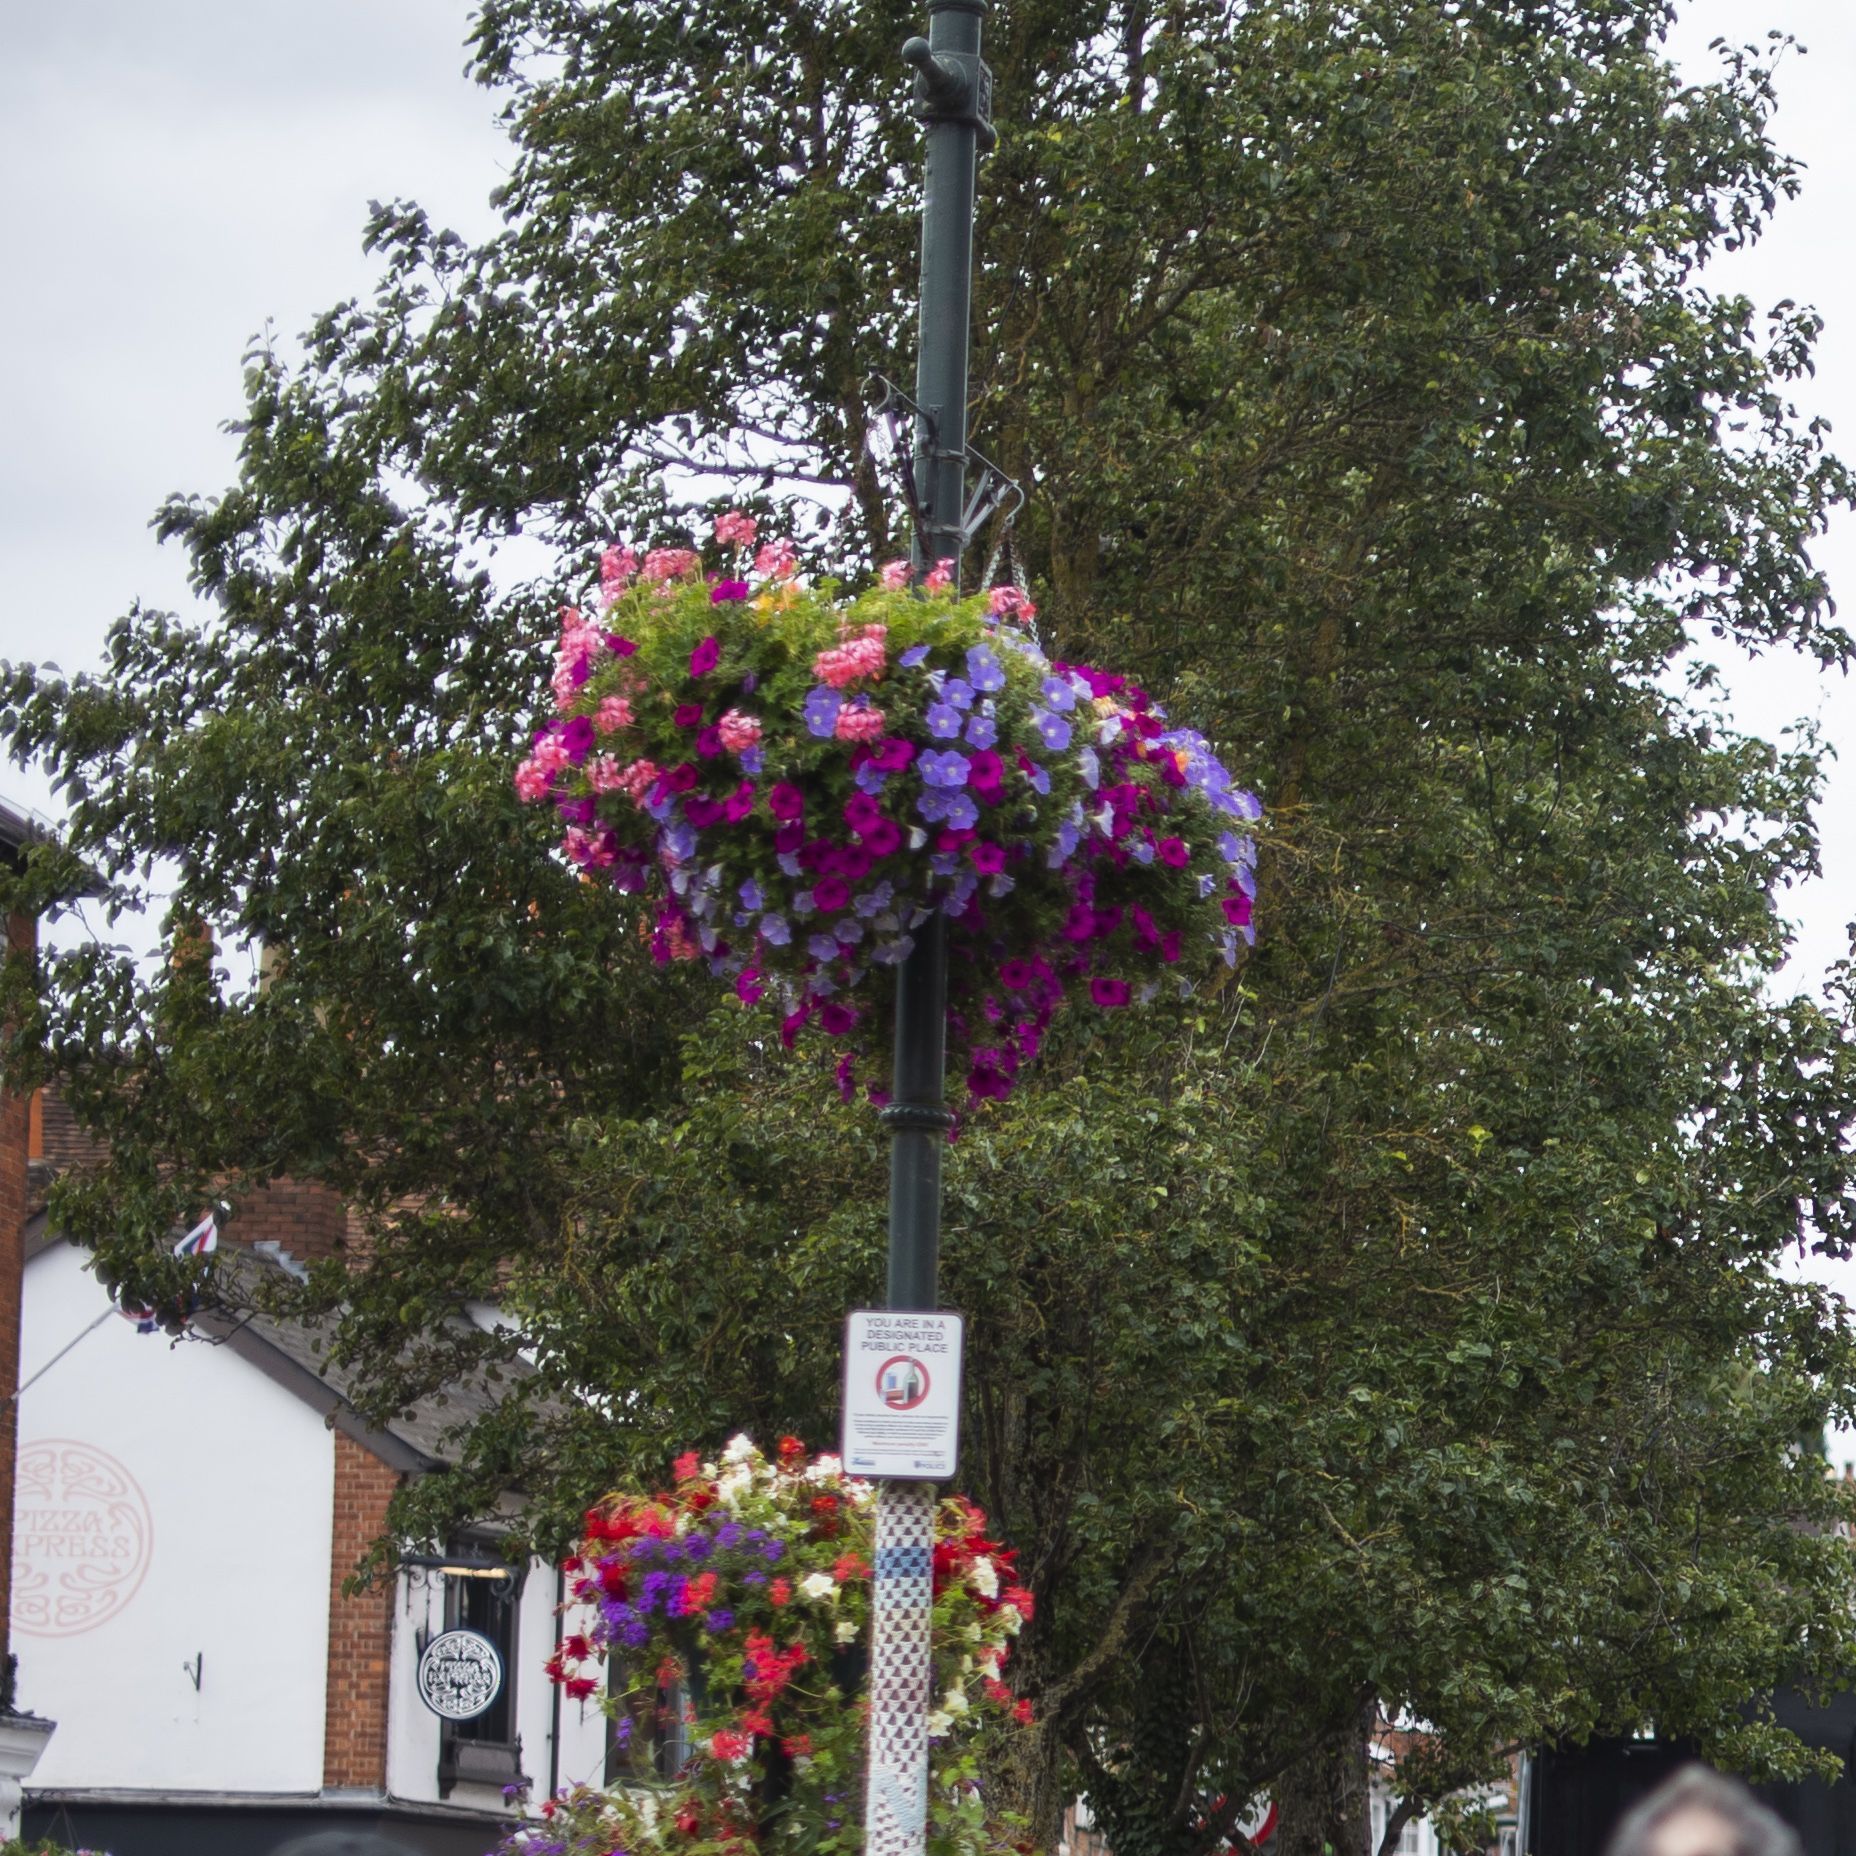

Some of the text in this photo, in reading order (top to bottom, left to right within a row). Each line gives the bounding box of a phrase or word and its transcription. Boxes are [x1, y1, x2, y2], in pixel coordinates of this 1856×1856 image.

[866, 1317, 946, 1329] YOU ARE IN A
[867, 1329, 944, 1341] DESIGNATED
[861, 1341, 949, 1354] PUBLIC PLACE
